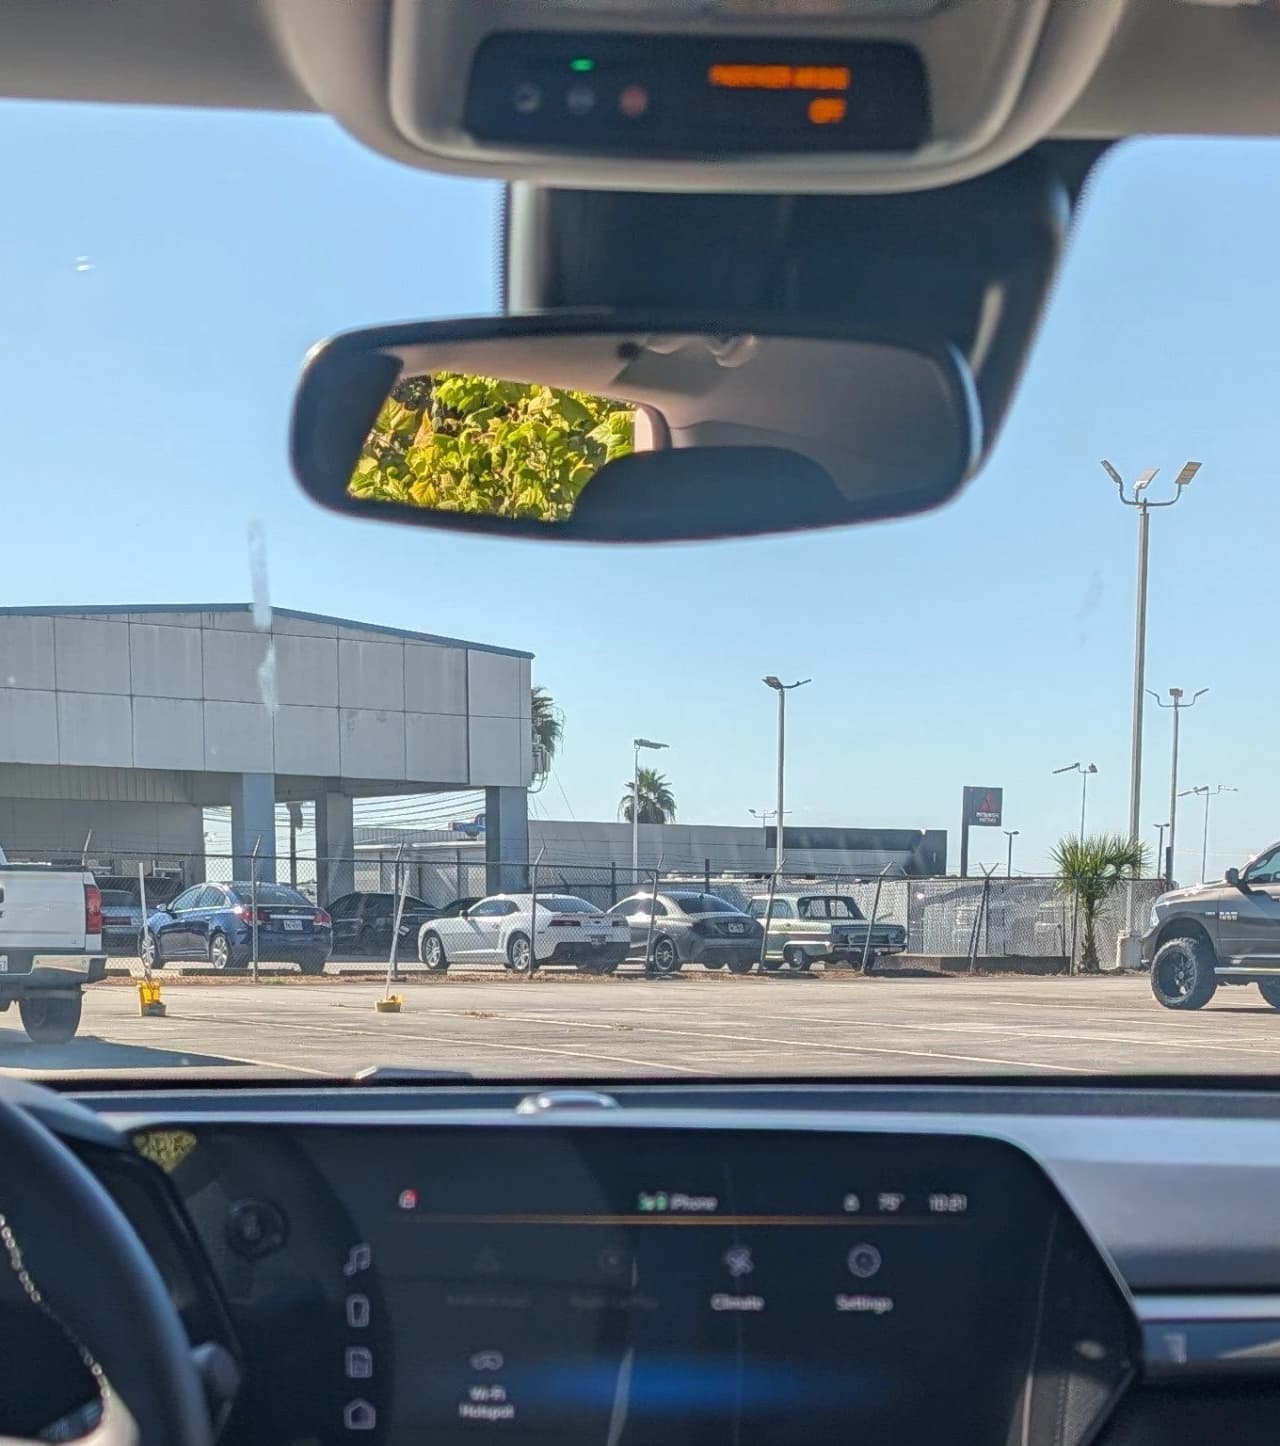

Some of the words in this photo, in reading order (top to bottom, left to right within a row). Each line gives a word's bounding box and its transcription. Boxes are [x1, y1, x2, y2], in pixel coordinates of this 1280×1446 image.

[710, 1293, 765, 1311] Climate
[835, 1294, 895, 1315] Settings
[469, 1384, 508, 1401] Wi-Fi
[458, 1402, 516, 1420] Hotspot
